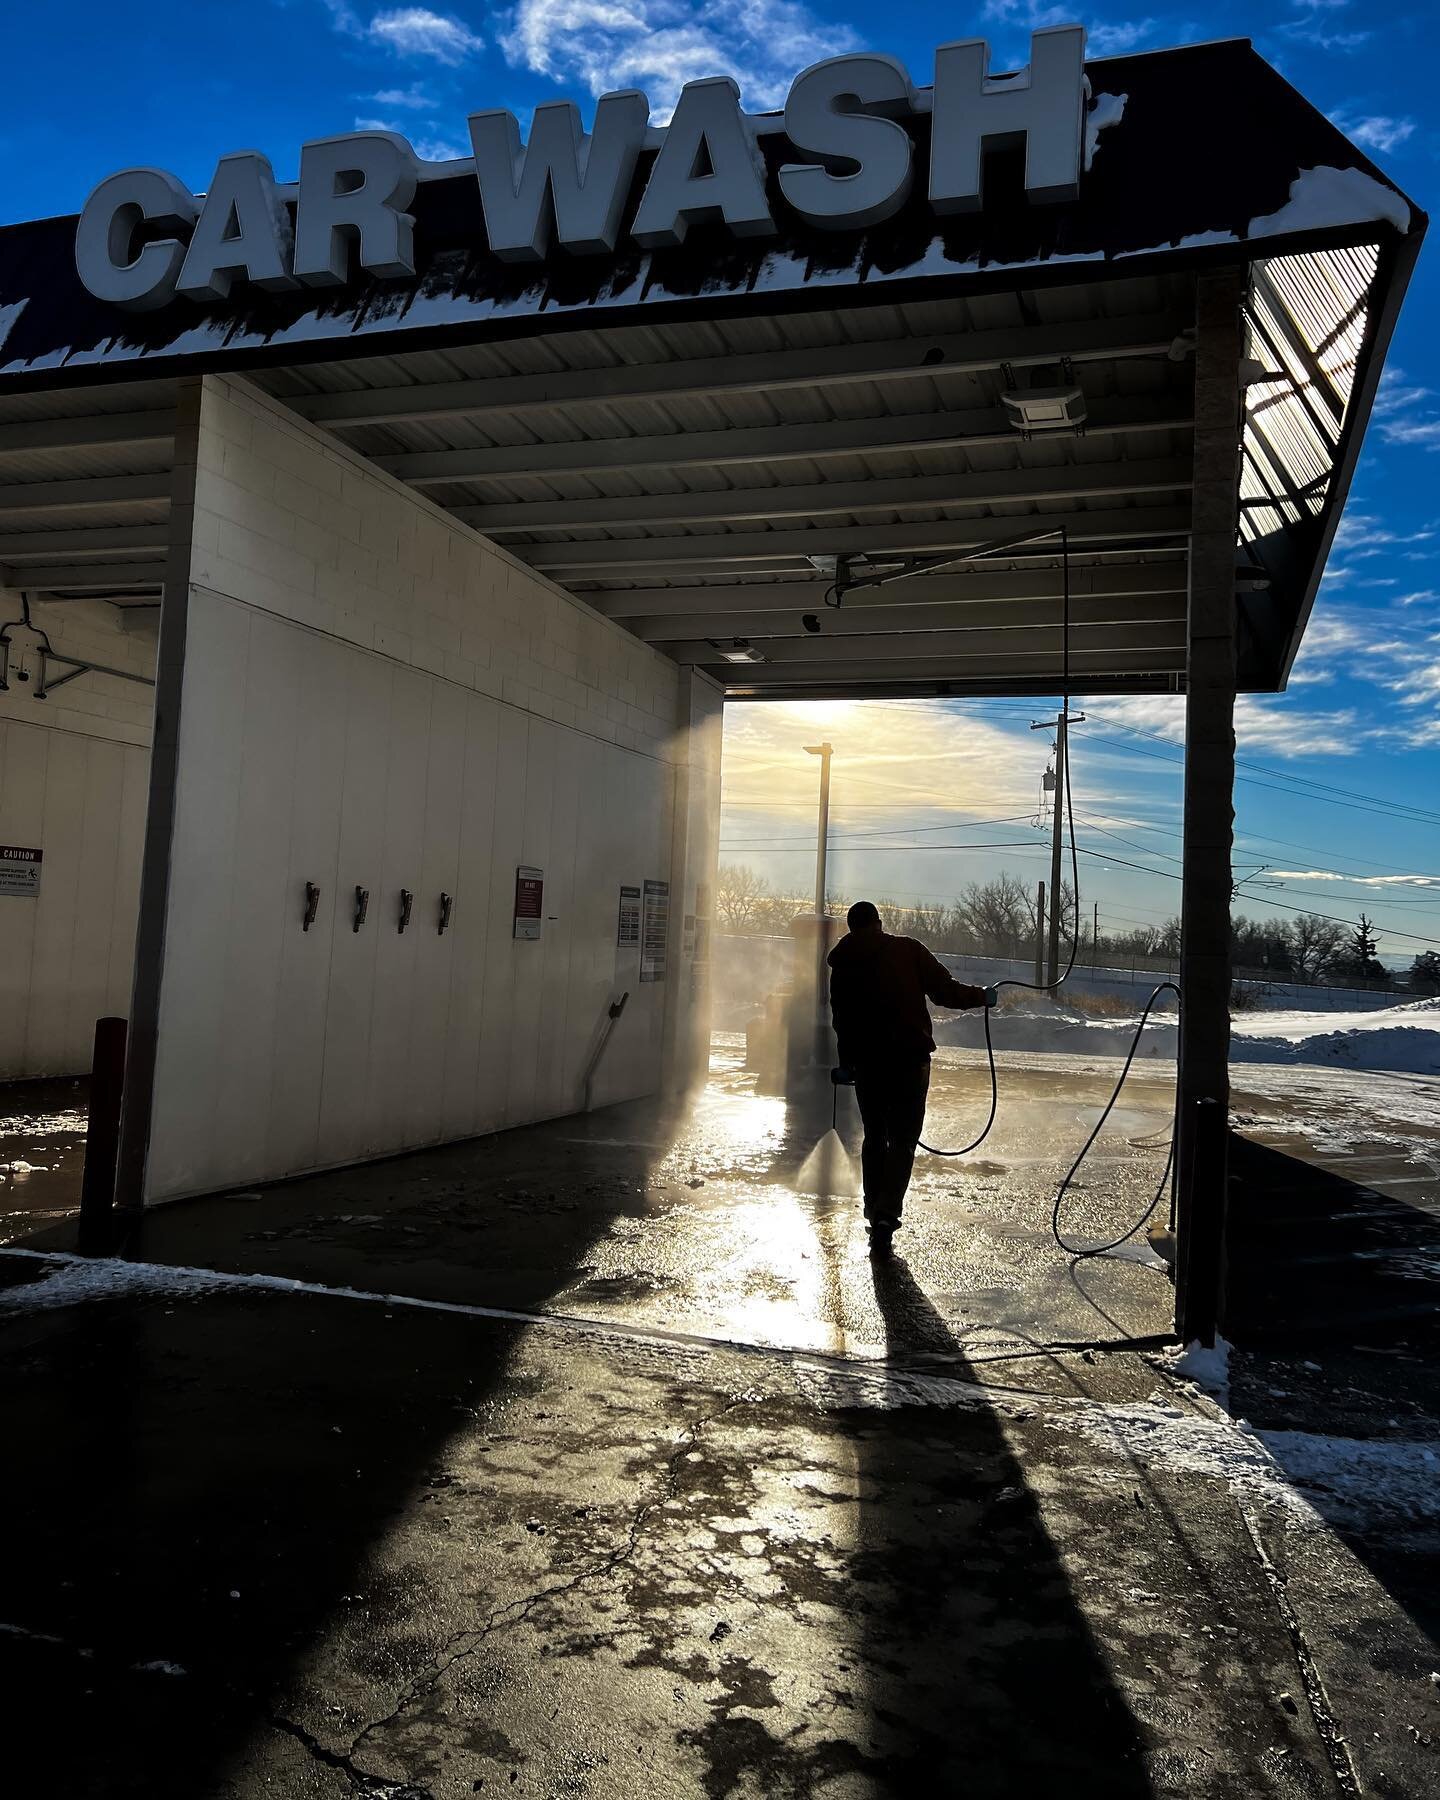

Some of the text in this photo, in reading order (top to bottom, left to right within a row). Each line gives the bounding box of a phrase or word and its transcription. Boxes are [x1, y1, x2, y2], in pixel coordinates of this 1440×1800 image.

[75, 23, 1087, 309] CAR WASH
[4, 849, 35, 860] CAUTION
